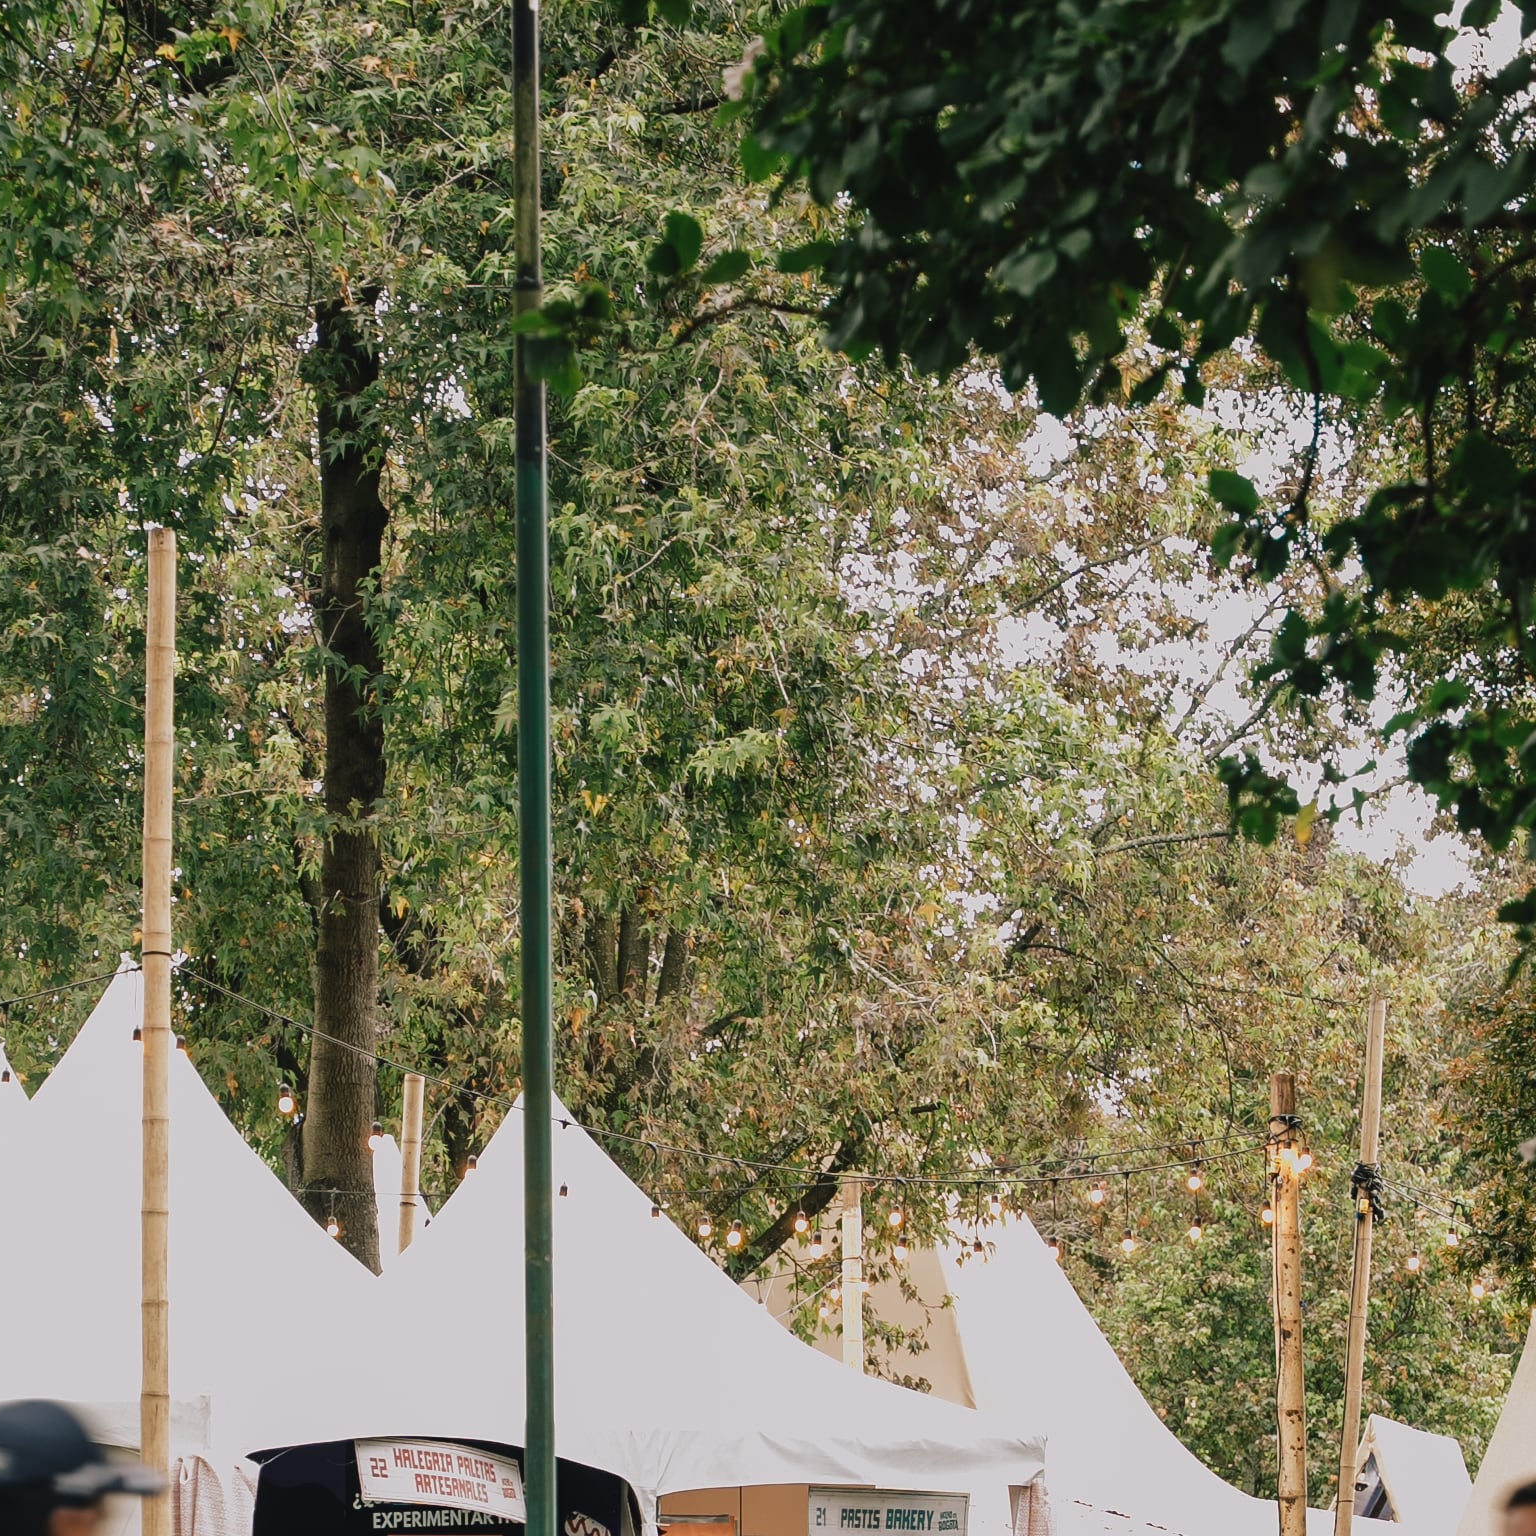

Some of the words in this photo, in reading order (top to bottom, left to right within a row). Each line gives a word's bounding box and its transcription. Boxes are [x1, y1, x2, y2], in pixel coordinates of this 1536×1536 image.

[369, 1457, 389, 1479] 22
[393, 1447, 454, 1474] HALEGRIA
[456, 1455, 497, 1483] PALETAS
[415, 1473, 489, 1503] ARTESANALES
[816, 1507, 826, 1526] 21
[840, 1508, 881, 1529] PASTIS
[885, 1508, 935, 1531] BAKERY
